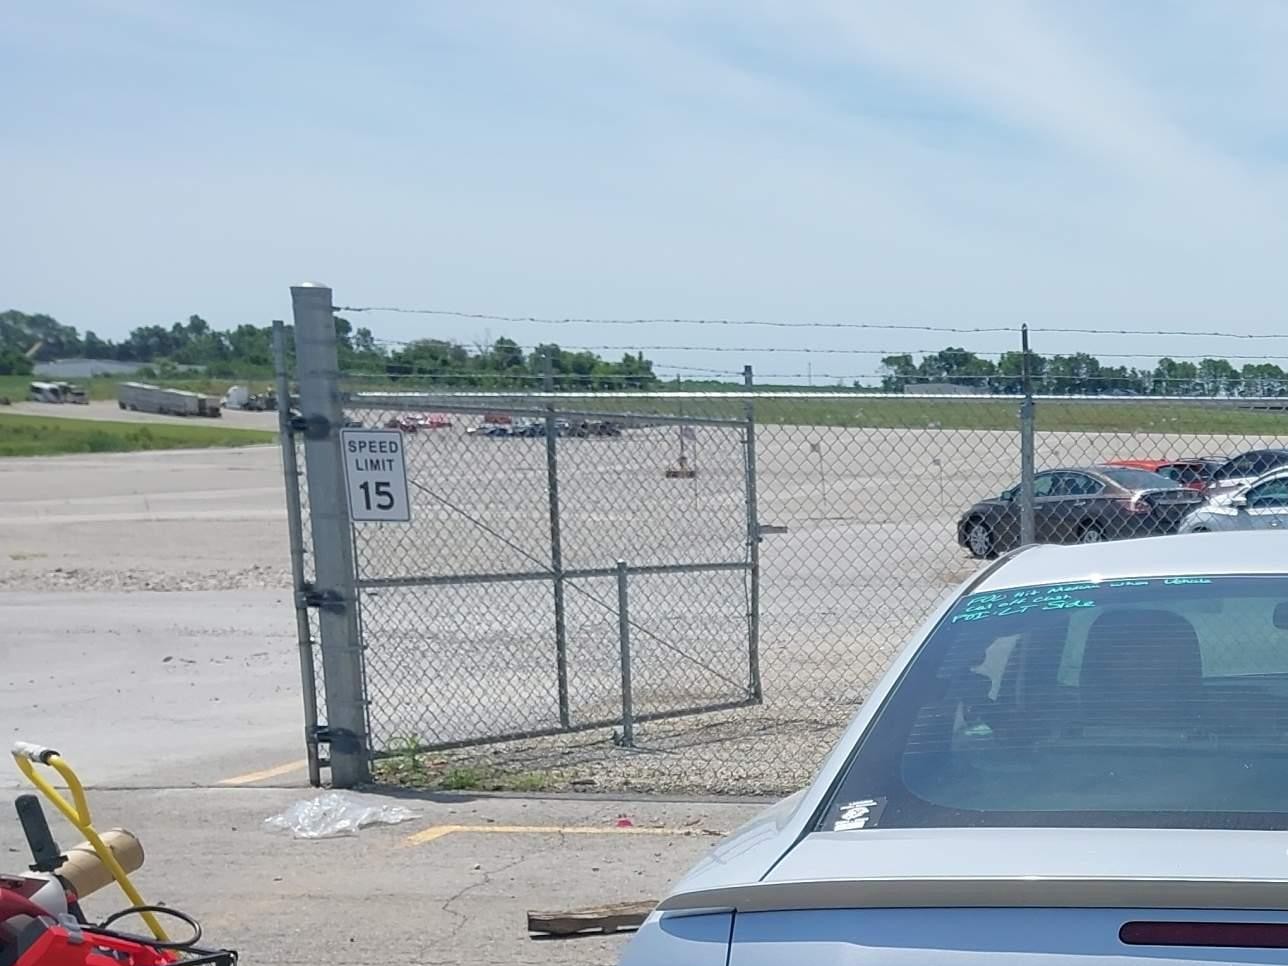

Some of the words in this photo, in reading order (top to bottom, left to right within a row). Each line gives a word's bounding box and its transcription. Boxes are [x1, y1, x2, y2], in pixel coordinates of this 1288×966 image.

[347, 440, 399, 453] SPEED
[355, 458, 395, 472] LIMIT
[359, 481, 395, 511] 15
